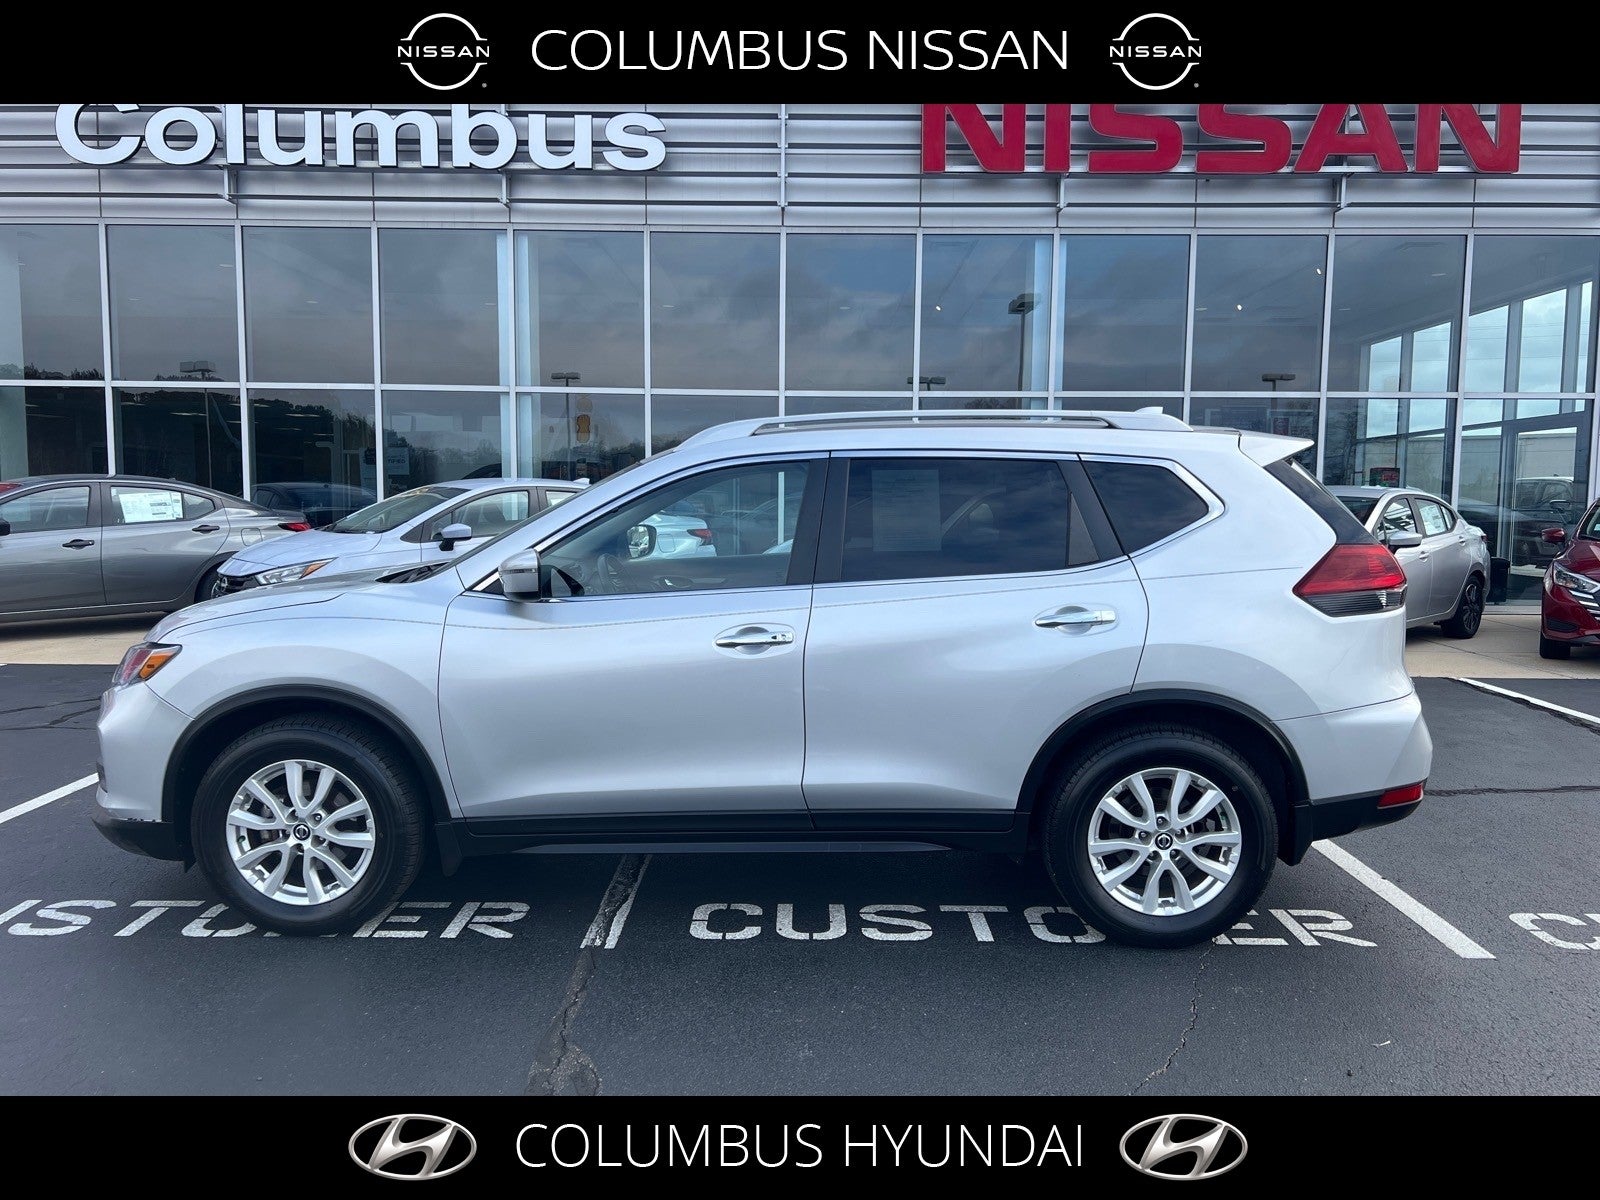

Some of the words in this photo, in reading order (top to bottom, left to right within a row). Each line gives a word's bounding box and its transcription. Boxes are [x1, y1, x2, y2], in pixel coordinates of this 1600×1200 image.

[54, 104, 667, 170] Columbus
[921, 104, 1521, 173] NISSAN
[690, 903, 1377, 947] CUSTOER
